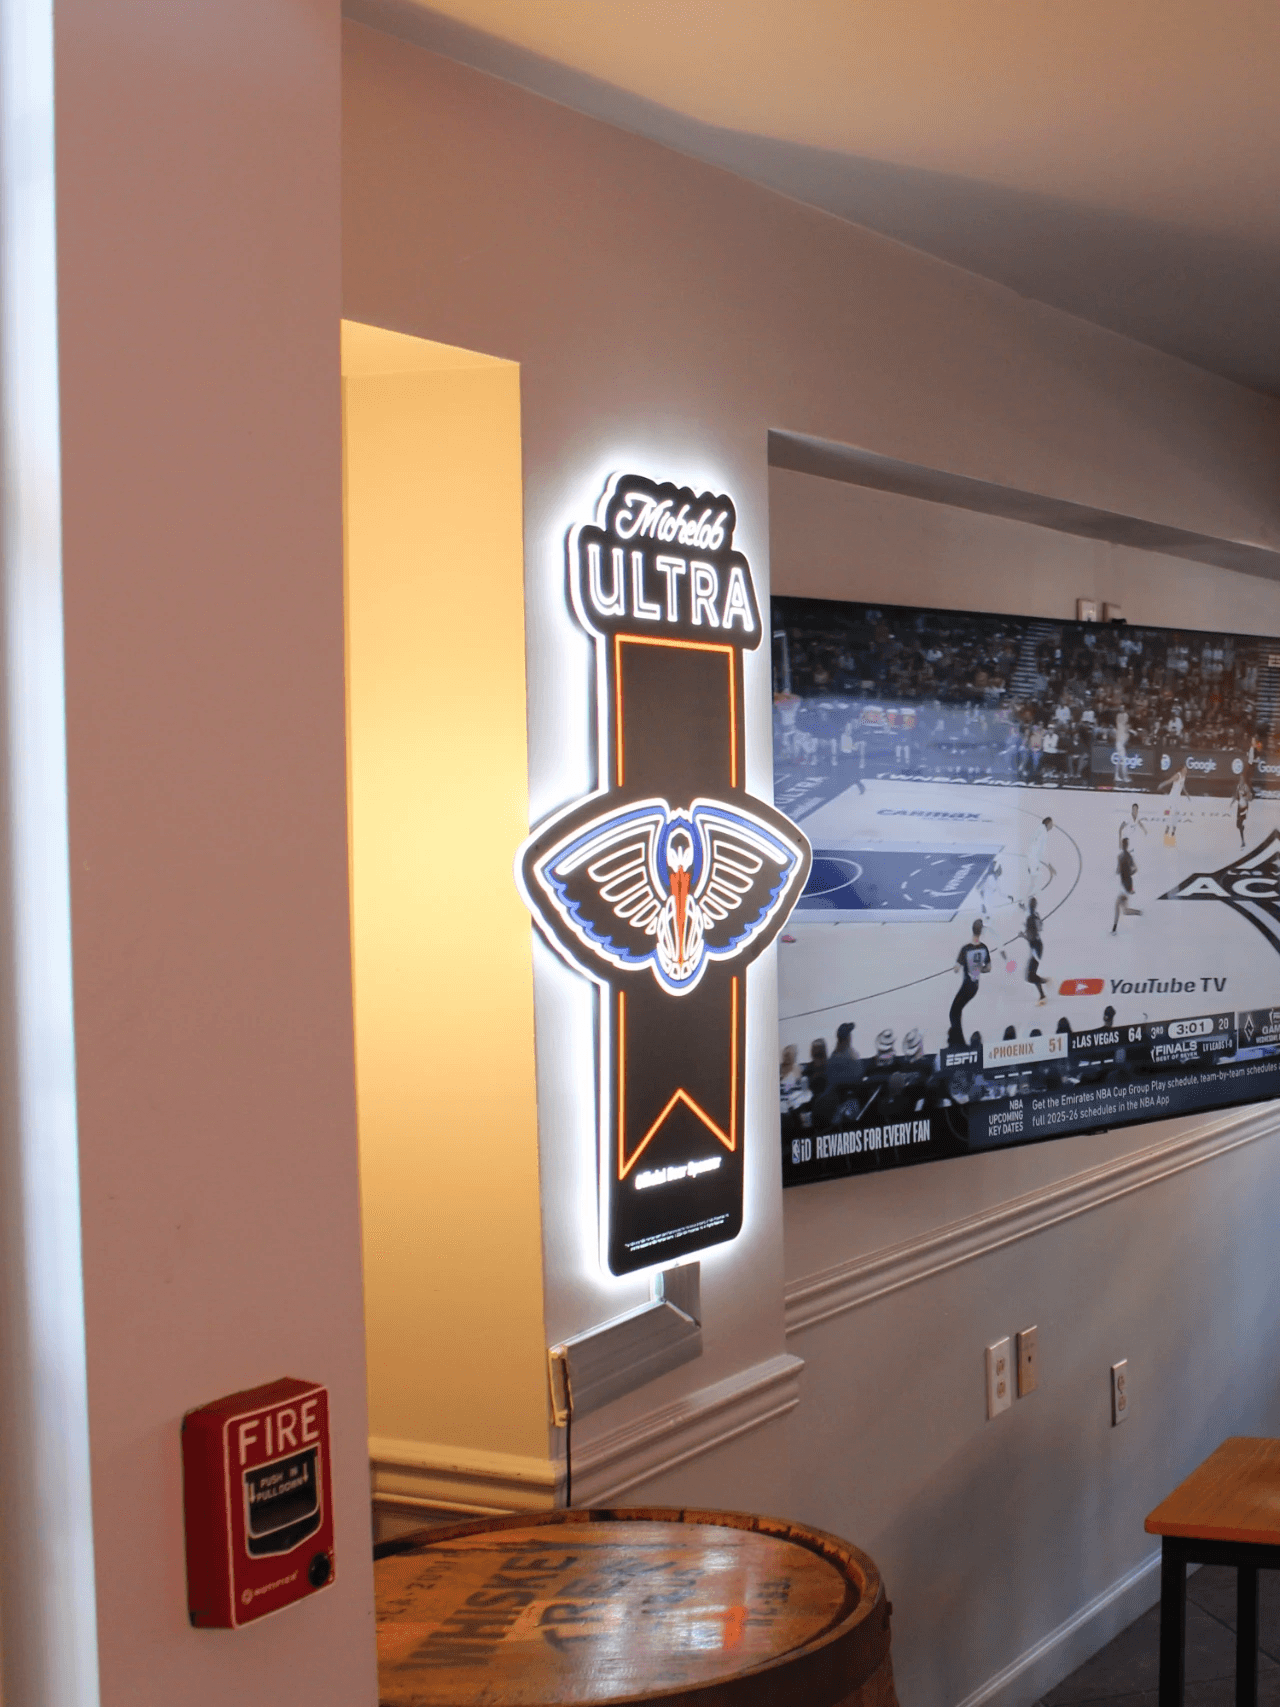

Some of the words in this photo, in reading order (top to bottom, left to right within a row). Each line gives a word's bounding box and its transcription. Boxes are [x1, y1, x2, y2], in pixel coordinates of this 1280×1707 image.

[615, 492, 728, 550] Michelob
[587, 543, 755, 632] ULTRA
[1186, 756, 1217, 773] Google
[1110, 978, 1196, 994] YouTube
[1200, 977, 1227, 992] TV
[1176, 1021, 1205, 1035] 3:01
[1218, 1018, 1229, 1030] 20
[1076, 1034, 1091, 1049] LAS
[1093, 1031, 1119, 1046] VEGAS
[1128, 1027, 1142, 1042] 64
[993, 1043, 1035, 1060] PHOENIX
[1048, 1037, 1063, 1052] 51
[1155, 1040, 1198, 1056] FINALS
[946, 1051, 978, 1067] ESPN
[1032, 1099, 1046, 1110] Get
[1047, 1097, 1060, 1108] the
[1061, 1092, 1095, 1106] Emirates
[1096, 1089, 1112, 1100] NBA
[1113, 1086, 1127, 1099] Cup
[1128, 1083, 1150, 1095] Group
[1151, 1079, 1166, 1092] Play
[1167, 1075, 1199, 1088] schedule,
[1200, 1068, 1245, 1083] team-by-team
[1246, 1062, 1278, 1076] schedules
[1009, 1099, 1024, 1110] NBA
[1032, 1115, 1046, 1127] full
[1047, 1110, 1079, 1124] 2025-26
[1080, 1104, 1117, 1119] schedules
[1118, 1102, 1126, 1112] in
[1126, 1100, 1138, 1111] the
[1139, 1096, 1155, 1109] NBA
[1156, 1094, 1170, 1107] App
[988, 1110, 1024, 1126] UPCOMING
[988, 1125, 1001, 1137] KEY
[1002, 1122, 1024, 1134] DATES
[816, 1130, 862, 1159] REWARDS
[863, 1127, 882, 1152] FOR
[883, 1122, 912, 1148] EVERY
[912, 1119, 930, 1143] FAN
[238, 1399, 320, 1466] FIRE
[260, 1472, 284, 1489] PUSH
[256, 1487, 279, 1503] PULL
